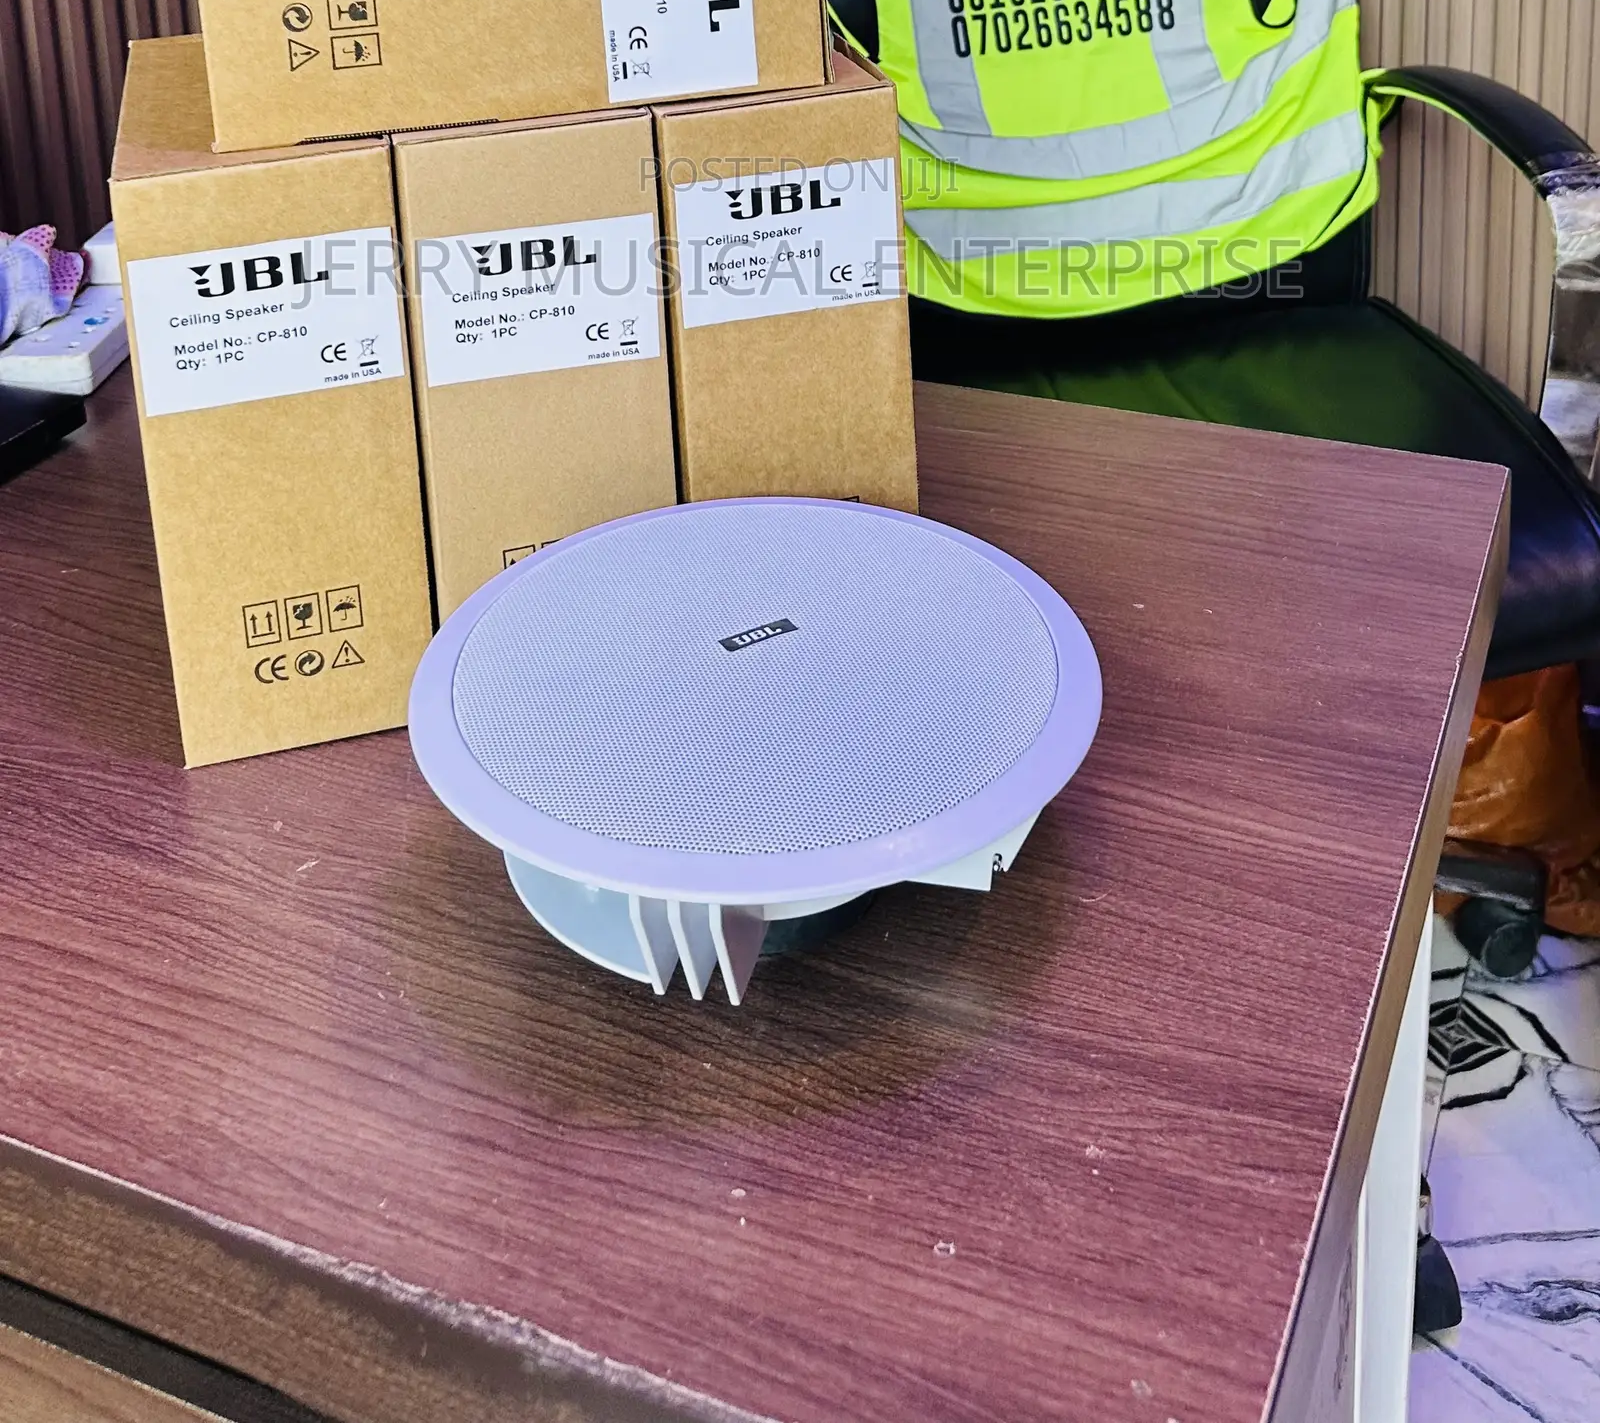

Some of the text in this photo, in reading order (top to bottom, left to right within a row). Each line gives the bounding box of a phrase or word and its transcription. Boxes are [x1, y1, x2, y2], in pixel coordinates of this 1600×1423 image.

[609, 30, 617, 53] made
[612, 64, 621, 82] USA
[730, 179, 841, 220] JBL
[705, 225, 802, 246] Ceiling Speaker
[478, 235, 597, 277] JBL
[707, 258, 746, 272] Model
[777, 247, 821, 263] CP-810
[196, 251, 329, 298] JBL
[709, 268, 767, 287] Qty: 1PC
[452, 282, 556, 304] Ceiling Speaker
[831, 292, 853, 301] made
[863, 288, 881, 298] USA
[169, 302, 285, 328] Ceiling Speaker
[455, 305, 575, 330] Model No.: CP-810
[174, 326, 308, 356] Model No.: CP-810
[455, 326, 518, 345] Qty: 1PC
[175, 350, 245, 372] Qty: 1PC
[587, 346, 640, 360] made in USA
[324, 367, 382, 383] made in USA
[734, 626, 782, 646] JBL
